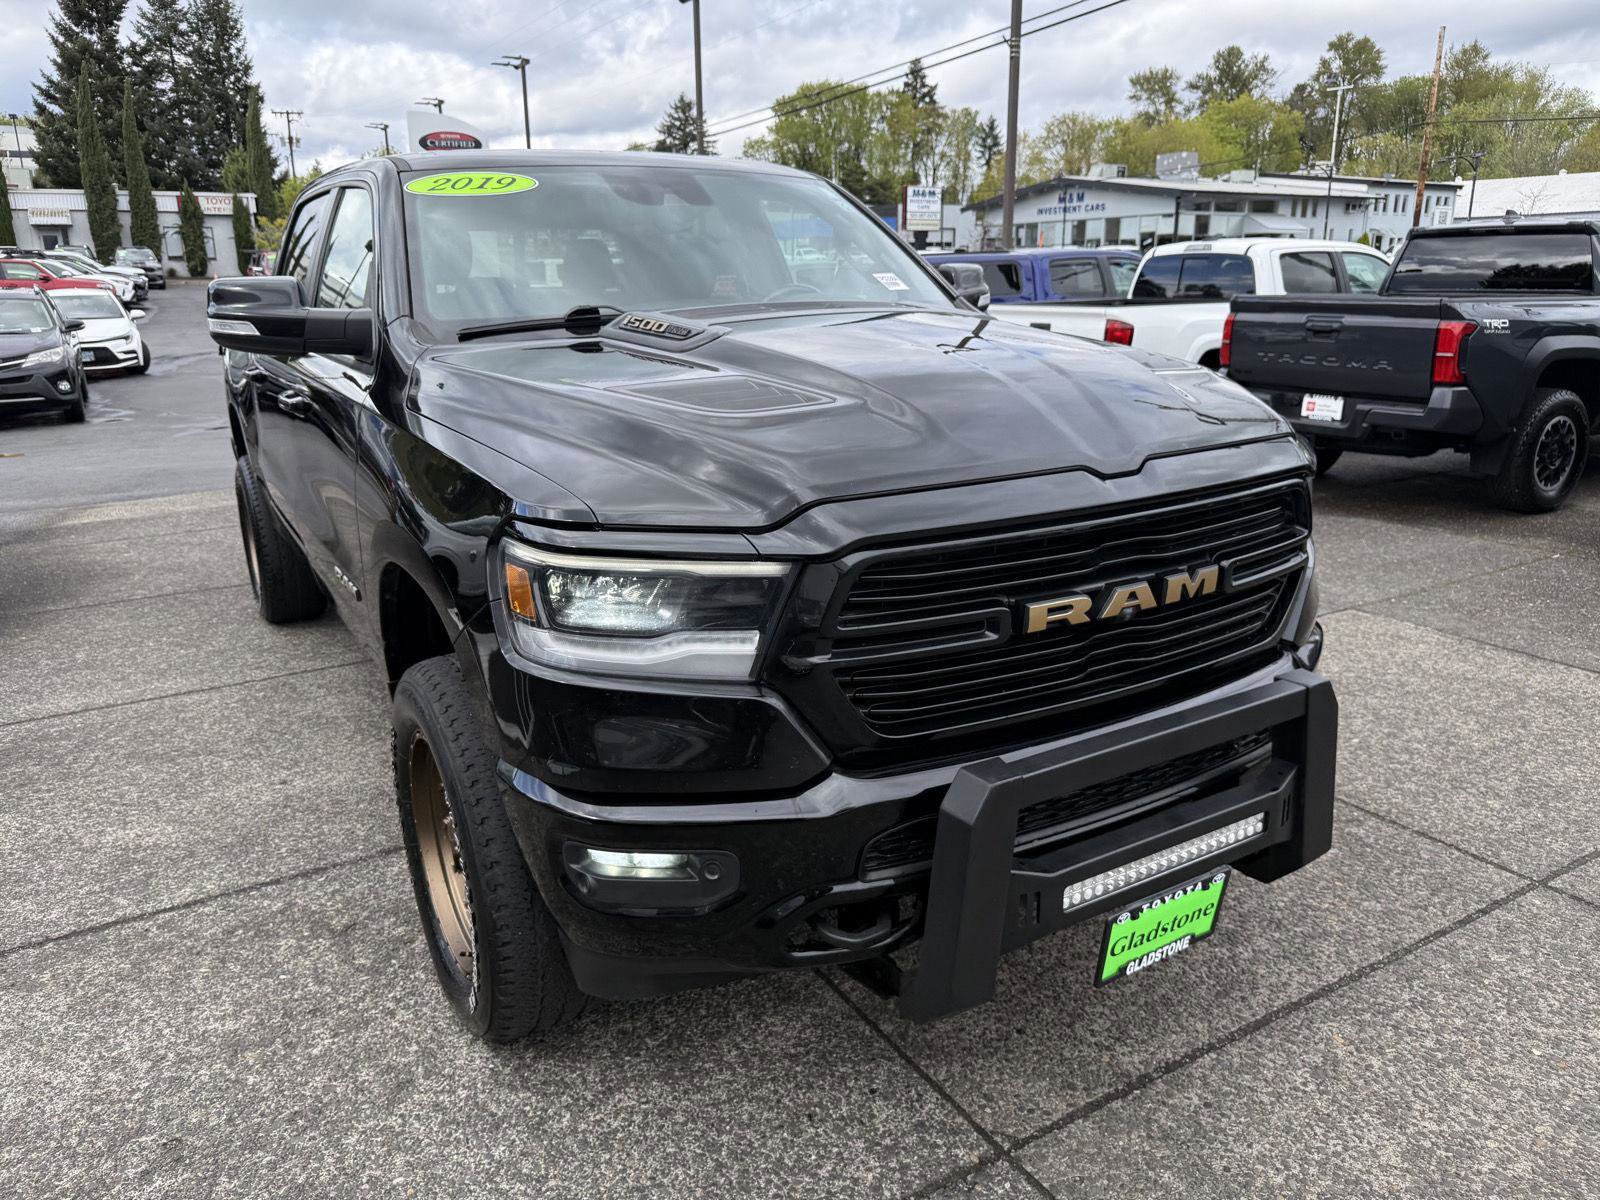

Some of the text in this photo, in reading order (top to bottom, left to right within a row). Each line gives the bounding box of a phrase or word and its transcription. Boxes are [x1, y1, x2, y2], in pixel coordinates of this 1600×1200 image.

[426, 139, 476, 148] CERTIFIED
[427, 176, 517, 191] 2019
[205, 197, 232, 205] TOYO
[1037, 203, 1106, 215] INVESTMENT CARS
[623, 315, 669, 333] 1500
[1257, 352, 1393, 371] TACOMA
[1026, 564, 1219, 634] RAM
[1142, 881, 1203, 914] TOYOTA
[1109, 901, 1215, 957] Gladstone
[1126, 935, 1192, 976] GLADSTONE
